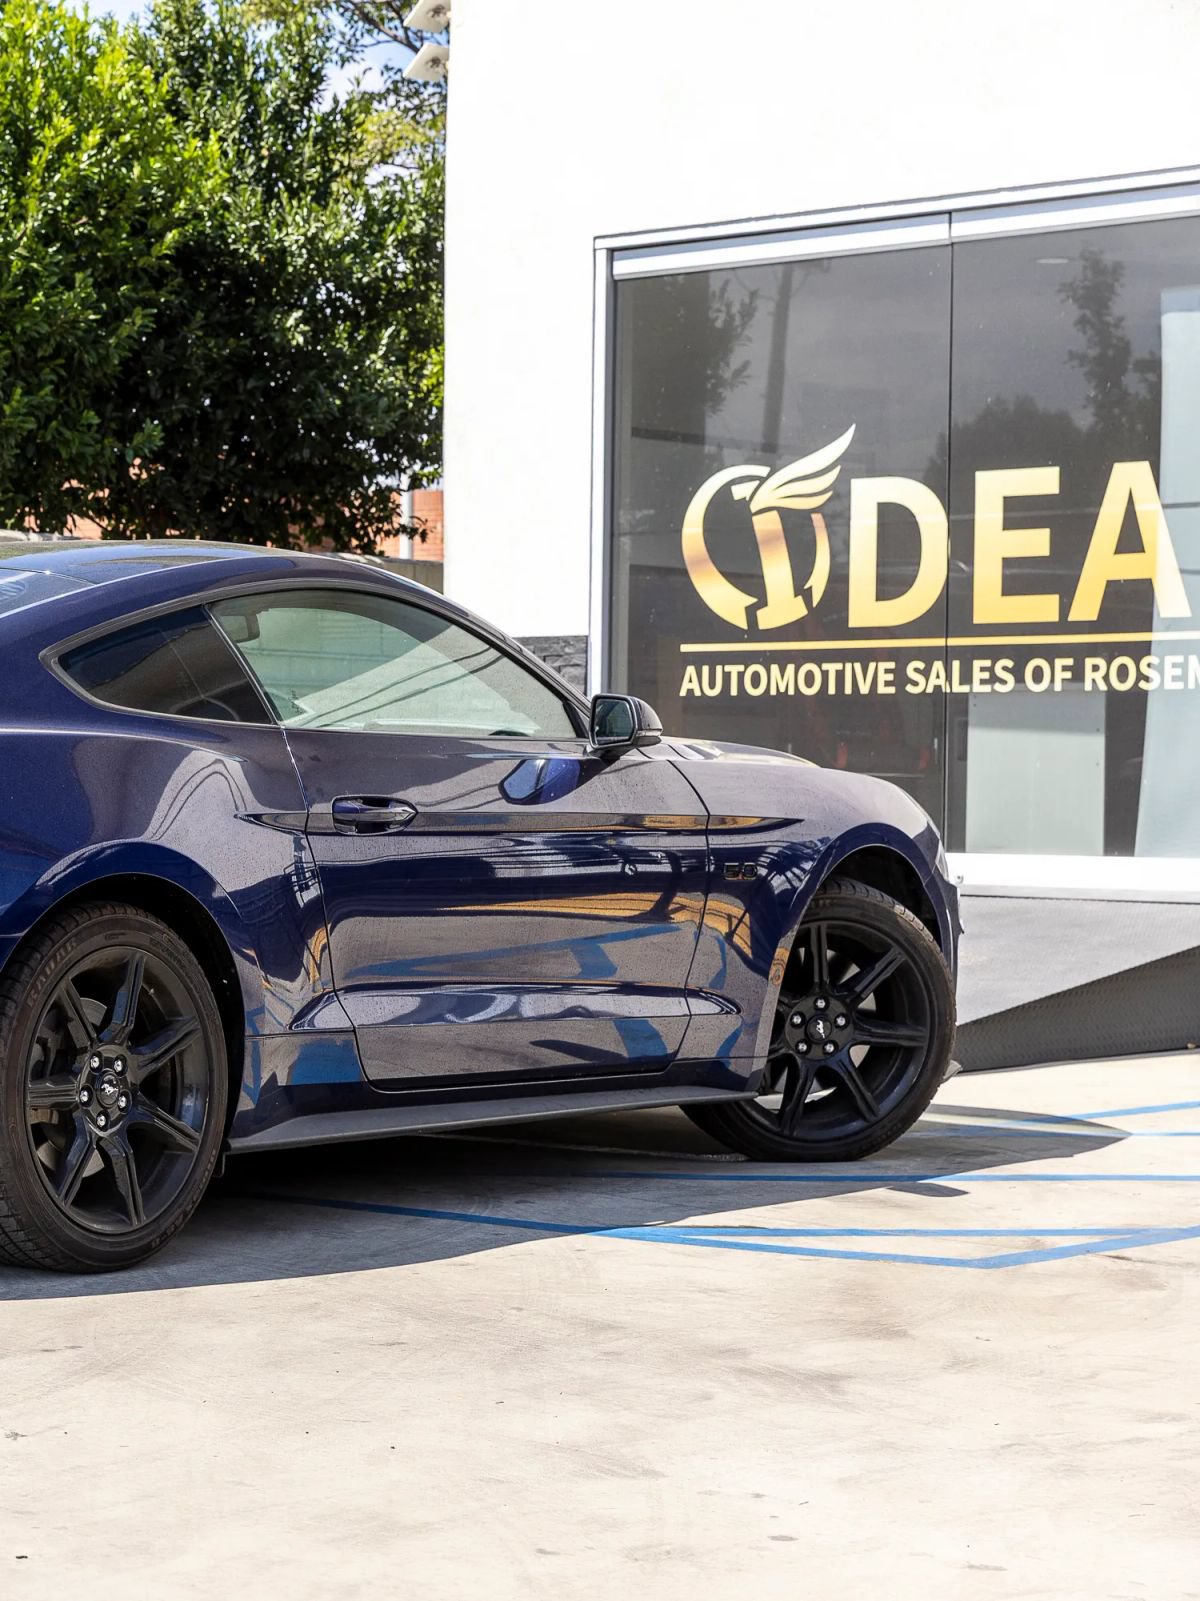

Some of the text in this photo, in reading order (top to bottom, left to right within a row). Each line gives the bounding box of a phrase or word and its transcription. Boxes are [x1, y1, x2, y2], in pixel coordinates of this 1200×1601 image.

[680, 661, 896, 697] AUTOMOTIVE
[905, 658, 1015, 694] SALES
[1024, 657, 1074, 693] OF
